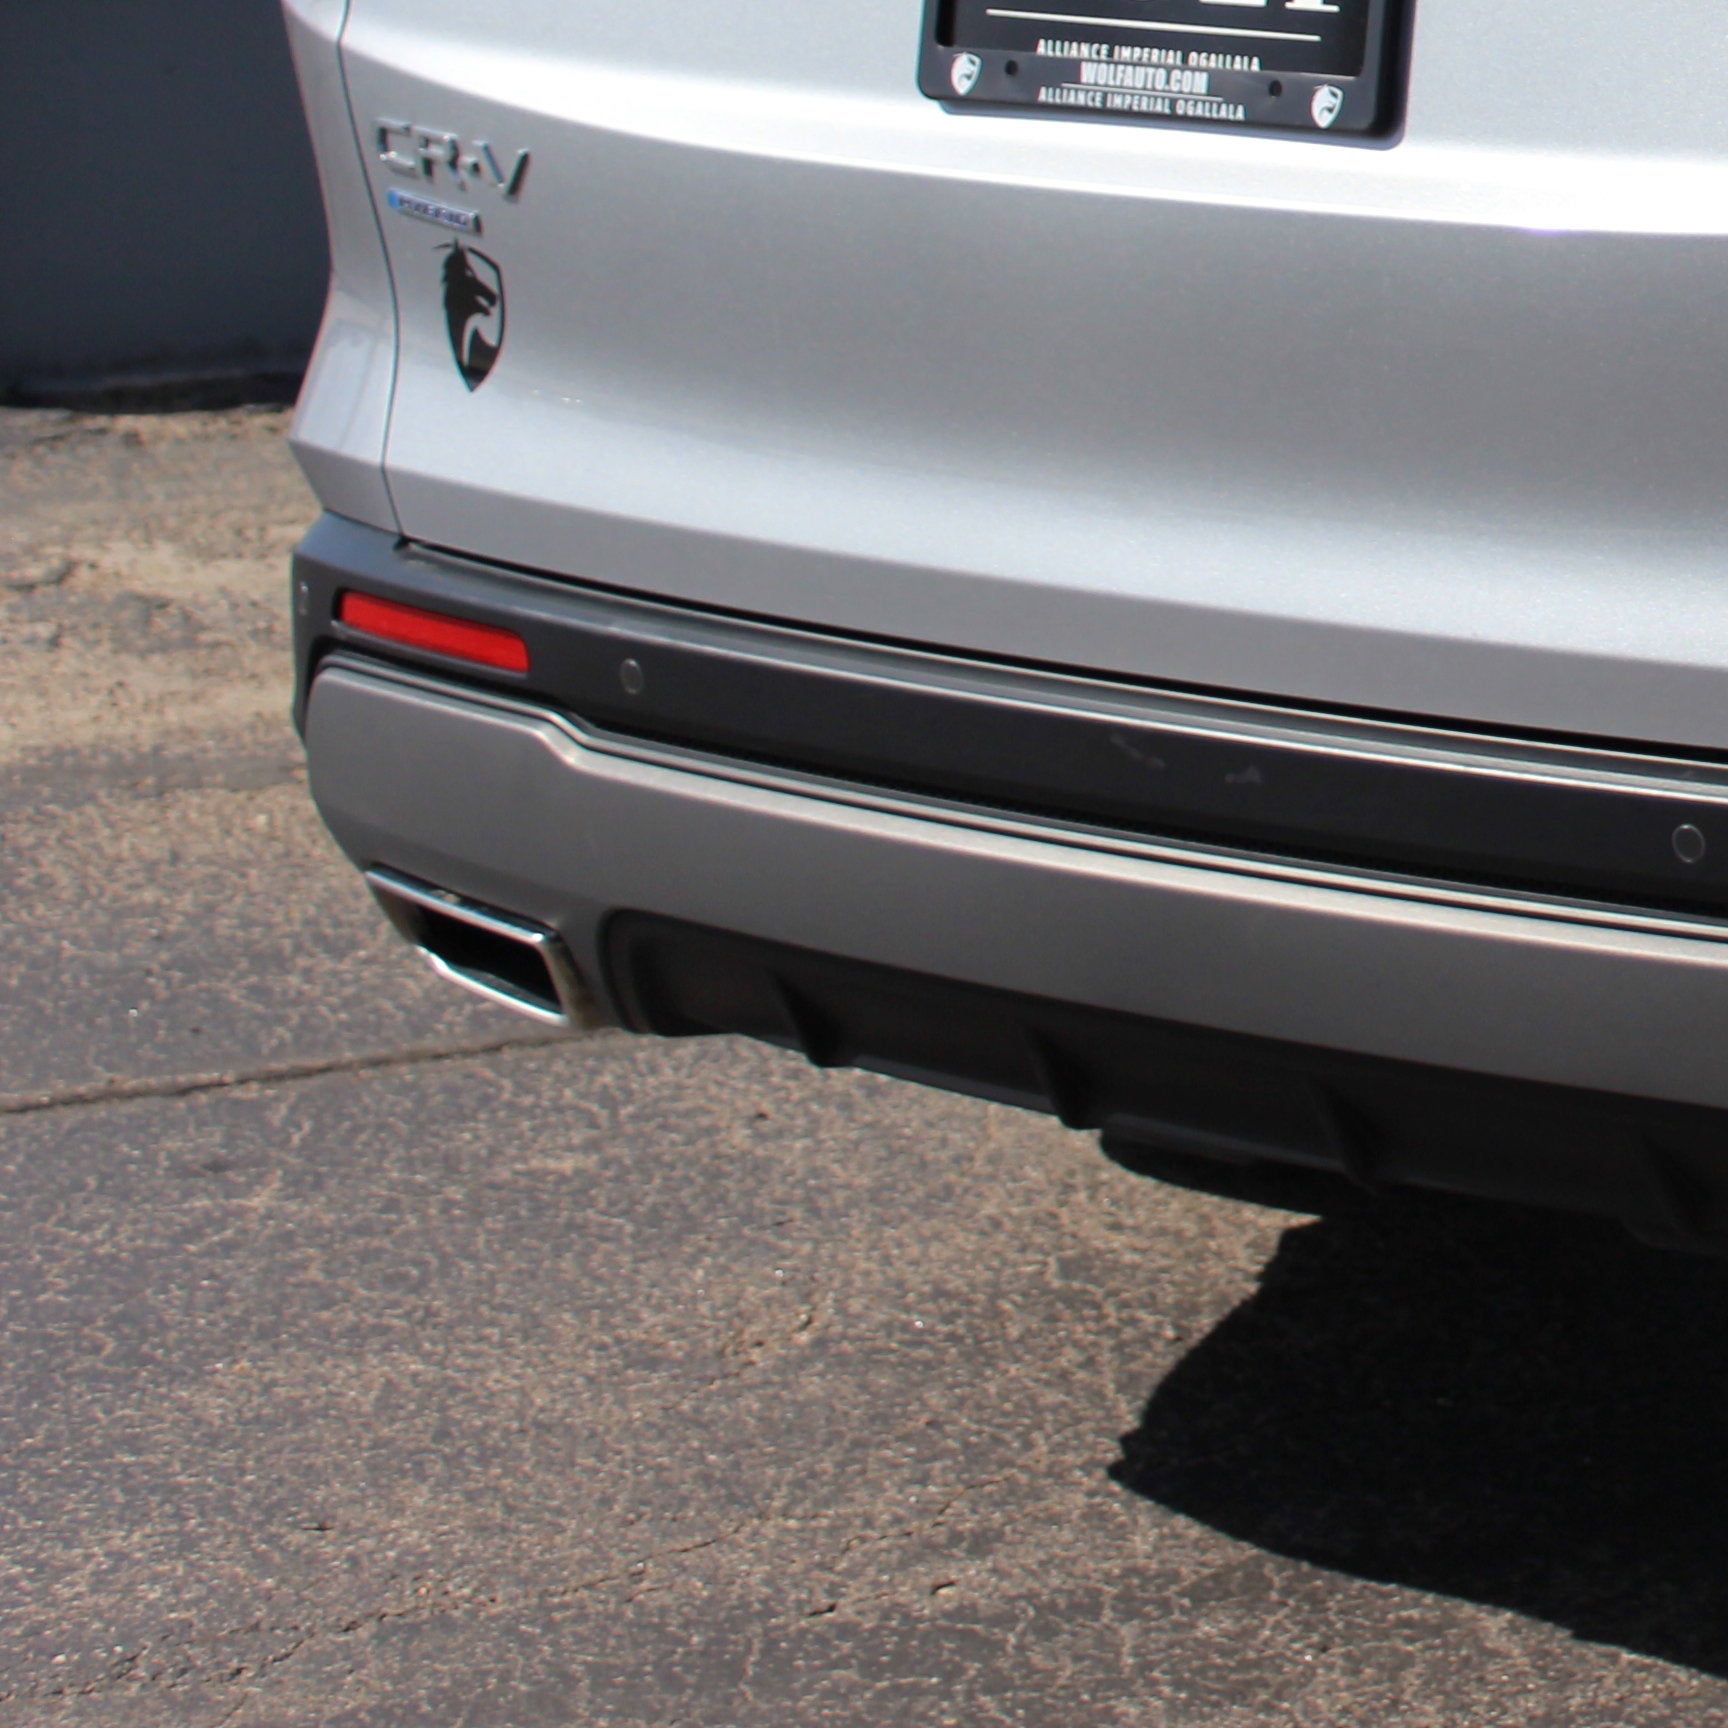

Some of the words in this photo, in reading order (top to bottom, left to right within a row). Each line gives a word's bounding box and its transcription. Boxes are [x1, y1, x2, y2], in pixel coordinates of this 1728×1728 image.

[1036, 38, 1111, 60] ALLIANCE
[1113, 44, 1184, 66] IMPERIAL
[1187, 51, 1261, 72] OGALLALA
[1080, 61, 1210, 95] WOLFAUTO.COM
[1037, 86, 1103, 108] ALLIANCE
[1106, 92, 1172, 115] IMPERIAL
[1175, 99, 1246, 121] OGALLALA
